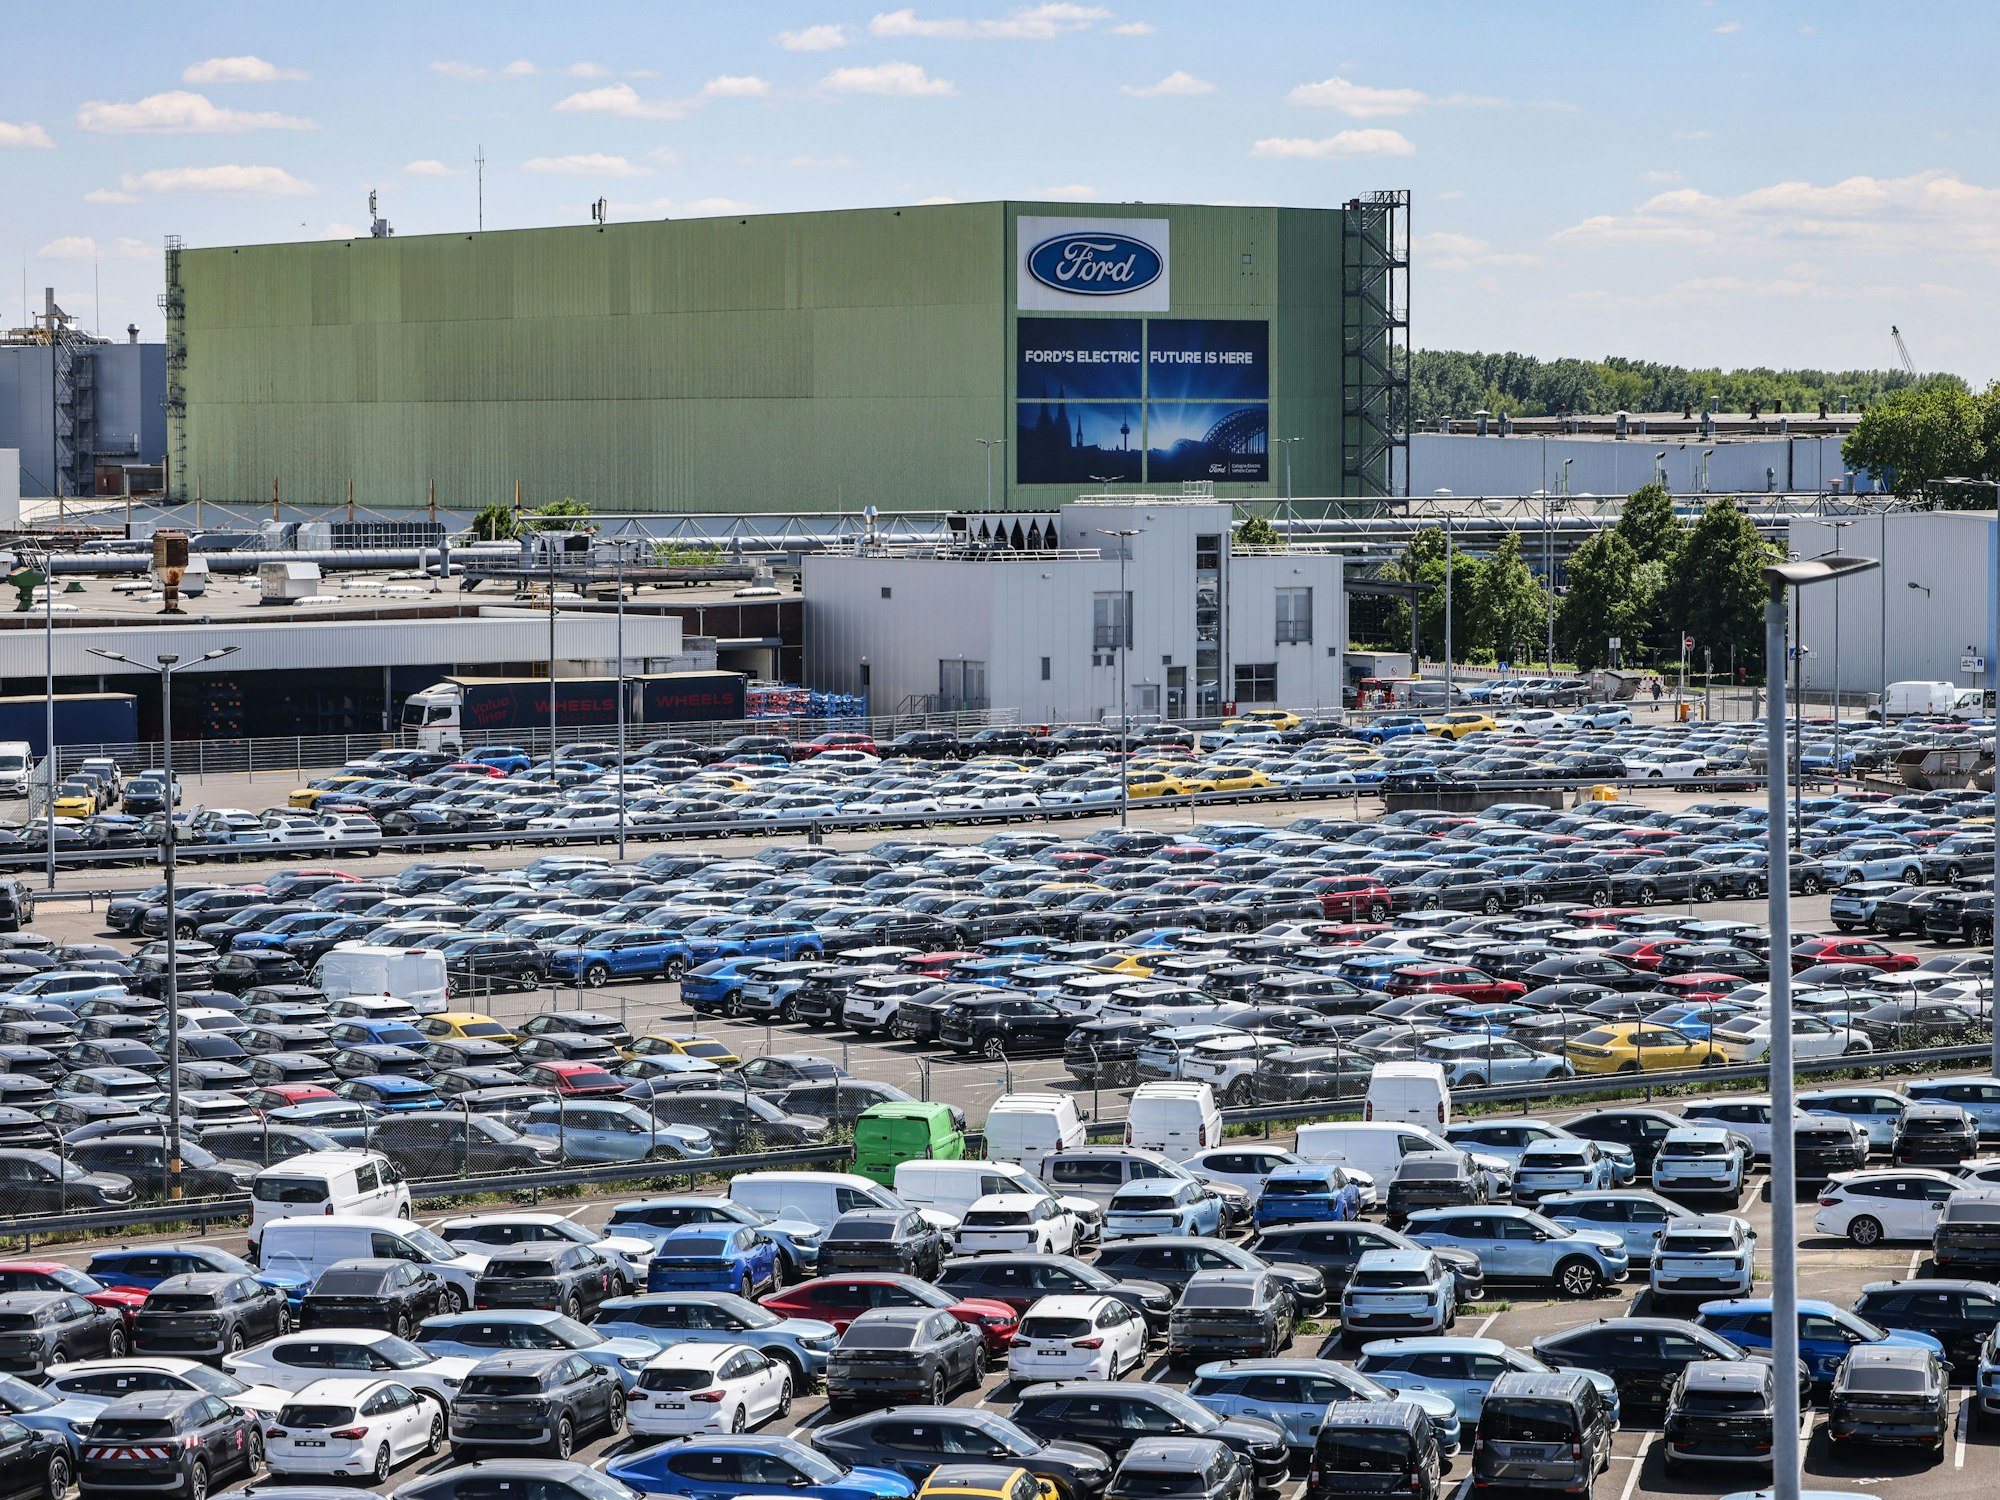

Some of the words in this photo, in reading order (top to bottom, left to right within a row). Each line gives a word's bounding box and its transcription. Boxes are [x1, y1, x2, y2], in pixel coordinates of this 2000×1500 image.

[1056, 241, 1136, 282] Ford
[1077, 350, 1140, 363] ELECTRIC
[1150, 351, 1202, 364] FUTURE
[1205, 352, 1217, 364] IS
[1219, 352, 1253, 364] HERE
[1208, 463, 1226, 473] Ford
[535, 699, 614, 712] WHEELS
[656, 693, 734, 707] WHEELS
[556, 714, 614, 722] OGISTICS
